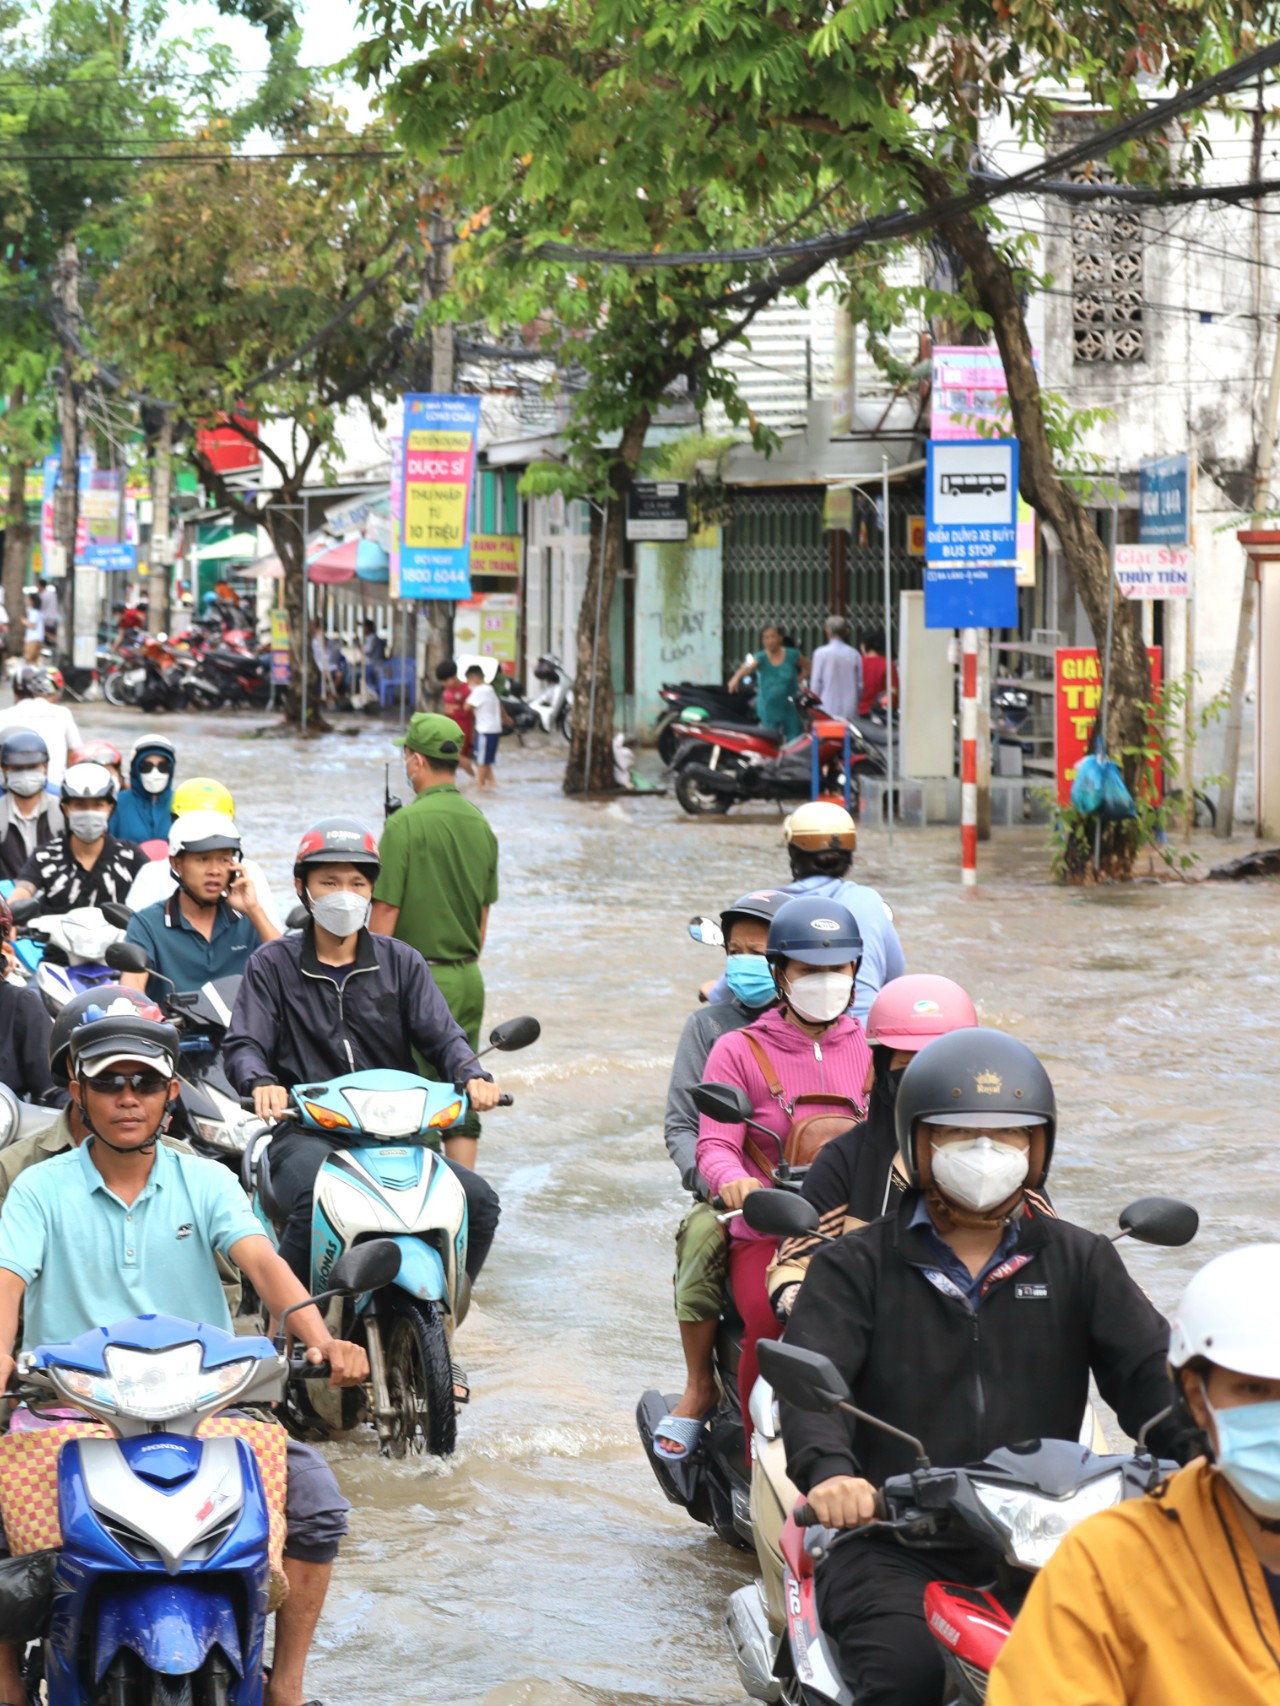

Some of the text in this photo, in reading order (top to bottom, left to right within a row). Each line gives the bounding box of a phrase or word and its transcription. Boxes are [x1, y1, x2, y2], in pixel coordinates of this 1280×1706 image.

[408, 459, 449, 479] DƯỢC
[979, 529, 991, 542] XE
[942, 543, 997, 558] BUS STOP
[403, 568, 466, 583] 1800 6044
[976, 1084, 1001, 1096] Royal
[141, 1443, 189, 1453] HONDA
[930, 1610, 960, 1647] YAMAHA
